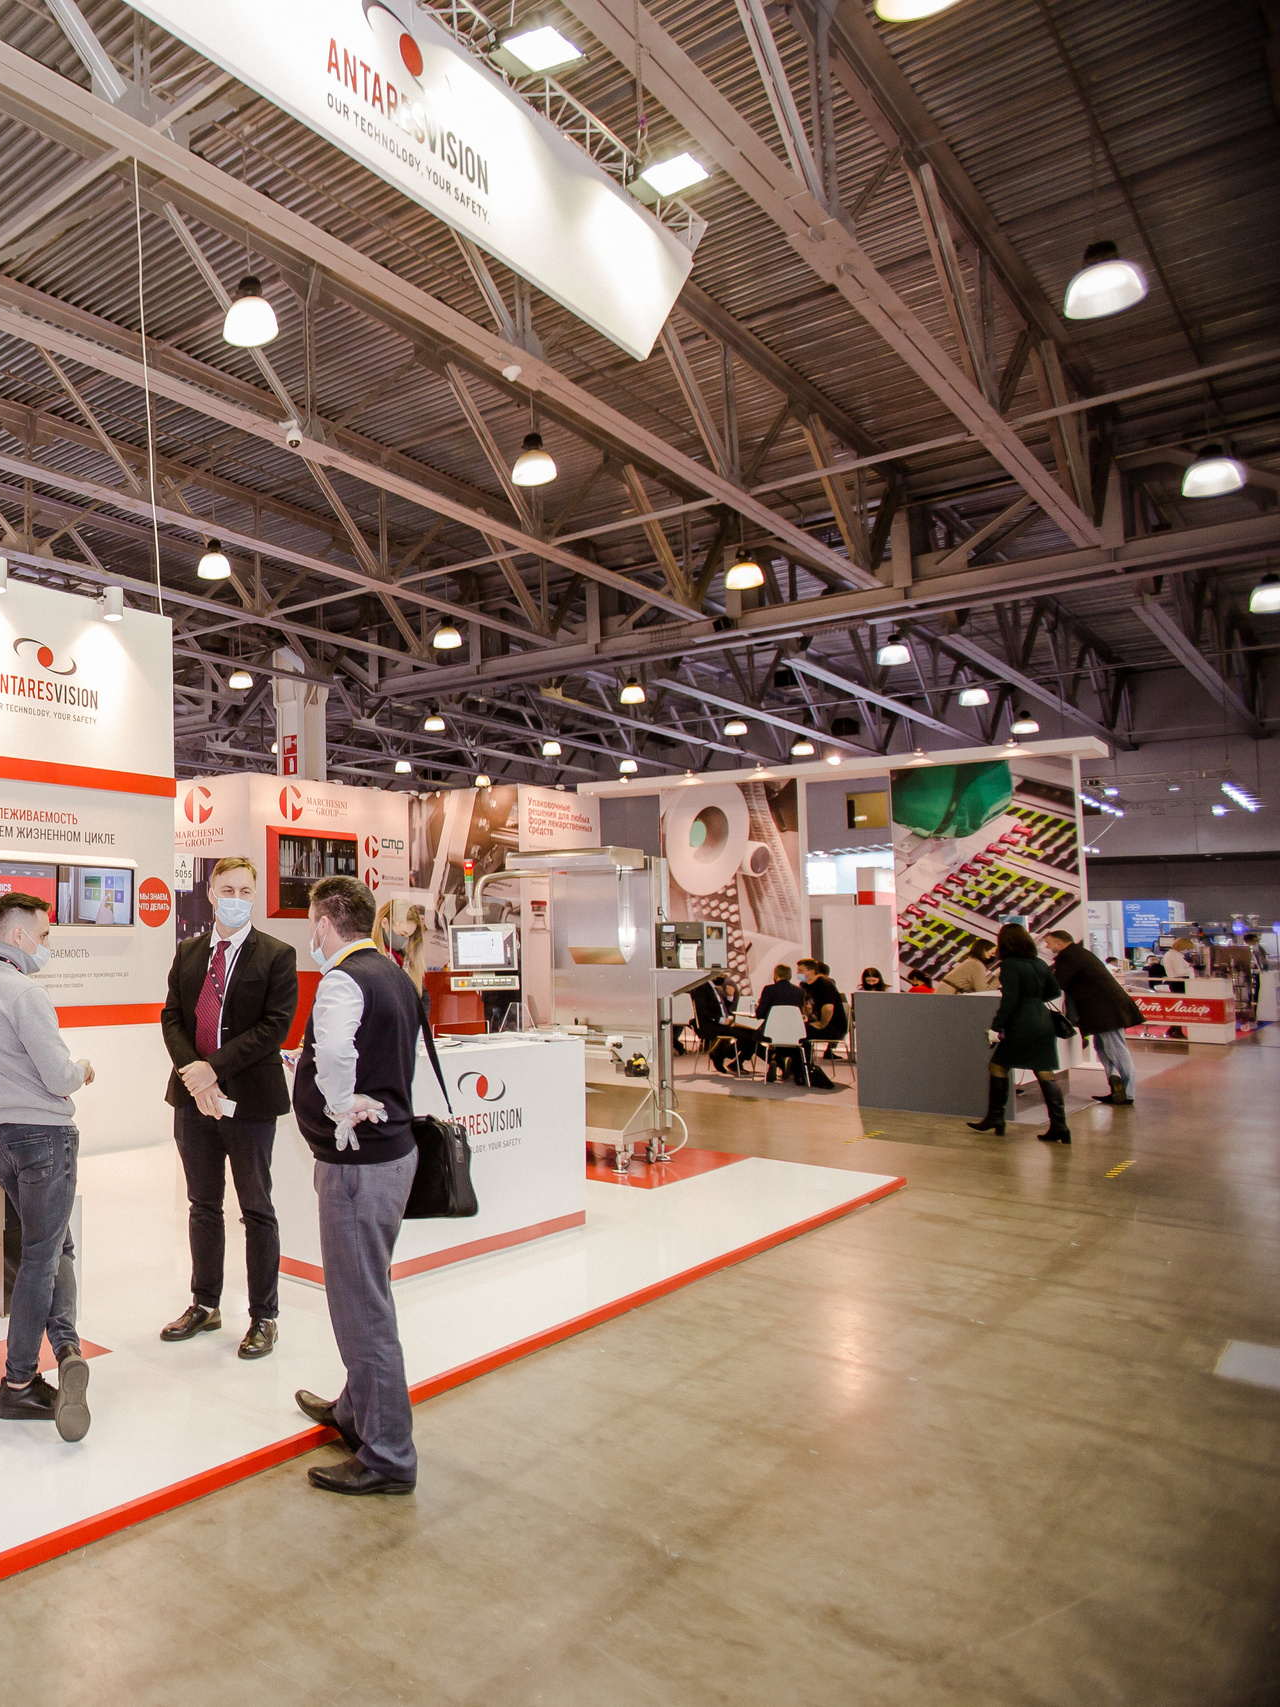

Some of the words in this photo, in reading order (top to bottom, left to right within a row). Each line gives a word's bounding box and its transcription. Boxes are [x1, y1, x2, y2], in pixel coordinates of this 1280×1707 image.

[327, 37, 489, 195] ANTARESVISION
[327, 92, 350, 121] OUR
[426, 165, 452, 194] YOUR
[454, 187, 491, 225] SAFETY.
[53, 711, 71, 721] YOUR
[306, 797, 348, 810] MARCHESINI
[527, 796, 571, 812] Упаковочные
[315, 808, 339, 817] GROUP
[528, 807, 557, 819] решения
[558, 812, 570, 821] для
[570, 813, 591, 824] любых
[528, 825, 554, 836] средств
[547, 819, 593, 833] лекарственных
[16, 827, 81, 843] ЖИЗНЕННОМ
[84, 831, 116, 846] ЦИКЛЕ
[175, 828, 224, 839] MARCHESINI
[185, 838, 213, 847] GROUP
[180, 860, 187, 869] A
[174, 869, 193, 879] 5055
[139, 892, 150, 901] МЫ
[150, 892, 169, 902] ЗНАЕМ,
[149, 902, 171, 912] ДЕЛАТЬ
[50, 949, 90, 959] ВАЕМОСТЬ
[1165, 1000, 1210, 1016] Лайф
[441, 1107, 522, 1137] TARESVISION
[488, 1141, 502, 1151] YOUR
[502, 1137, 522, 1148] SAFETY.
